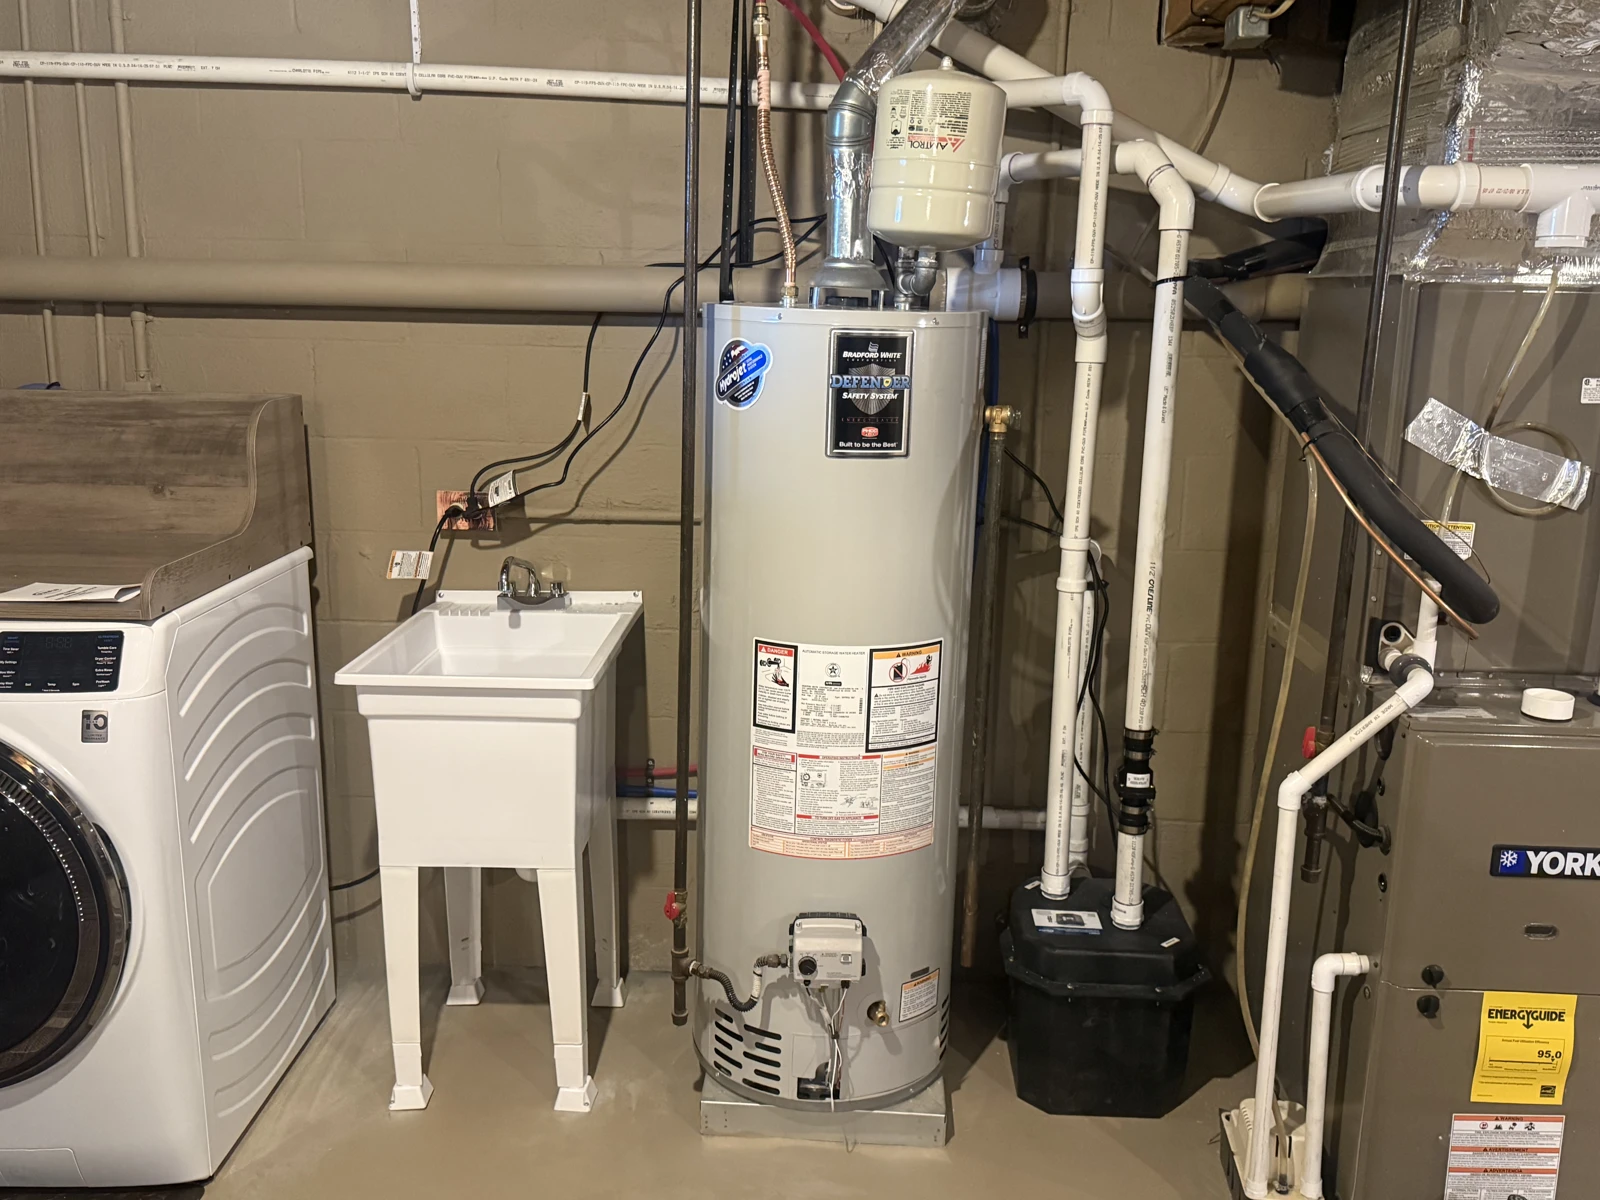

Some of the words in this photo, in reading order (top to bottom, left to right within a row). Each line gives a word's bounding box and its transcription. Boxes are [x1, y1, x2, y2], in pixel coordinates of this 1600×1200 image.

[719, 363, 748, 392] Hydrojet
[831, 375, 911, 389] DEFENDER
[1526, 851, 1600, 876] YORK
[1488, 1008, 1566, 1022] ENERGYGUIDE
[1538, 1050, 1562, 1058] 95.0
